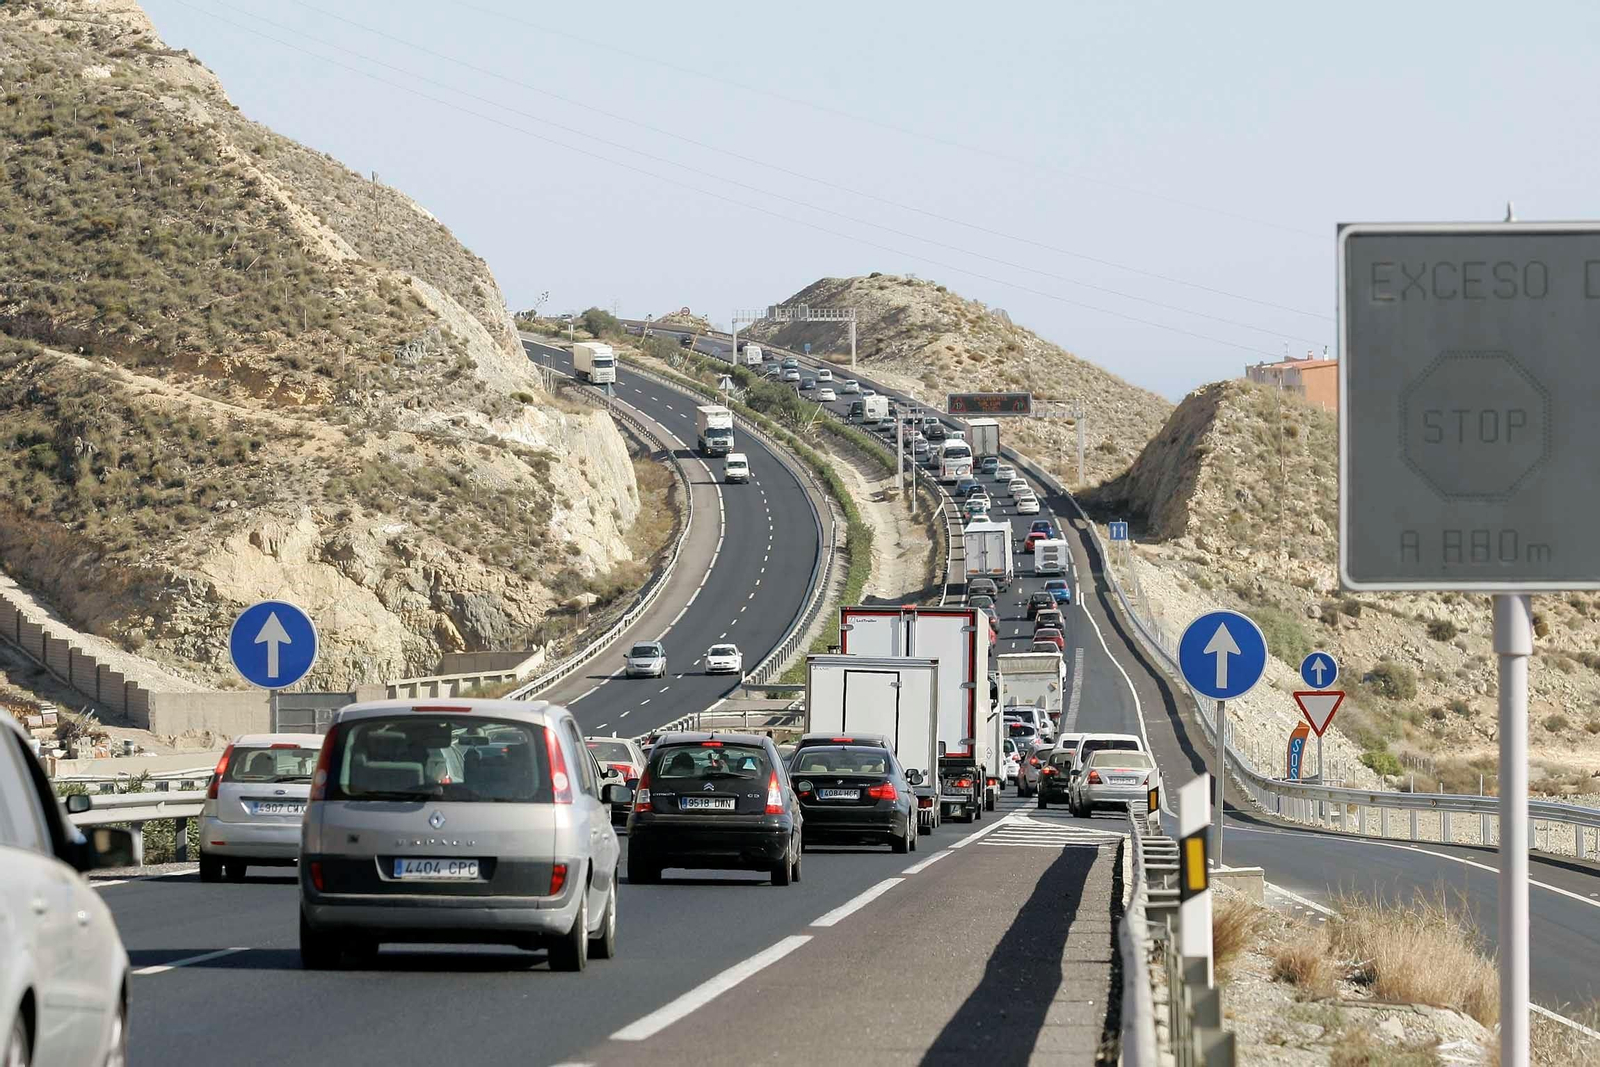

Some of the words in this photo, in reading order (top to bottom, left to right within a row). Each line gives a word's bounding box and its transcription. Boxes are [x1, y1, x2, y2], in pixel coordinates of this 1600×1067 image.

[1371, 260, 1548, 301] EXCESO
[1423, 409, 1527, 444] STOP
[1290, 738, 1302, 780] SOS
[688, 798, 710, 808] 9518
[405, 861, 441, 874] 4404
[448, 861, 477, 875] CPC
